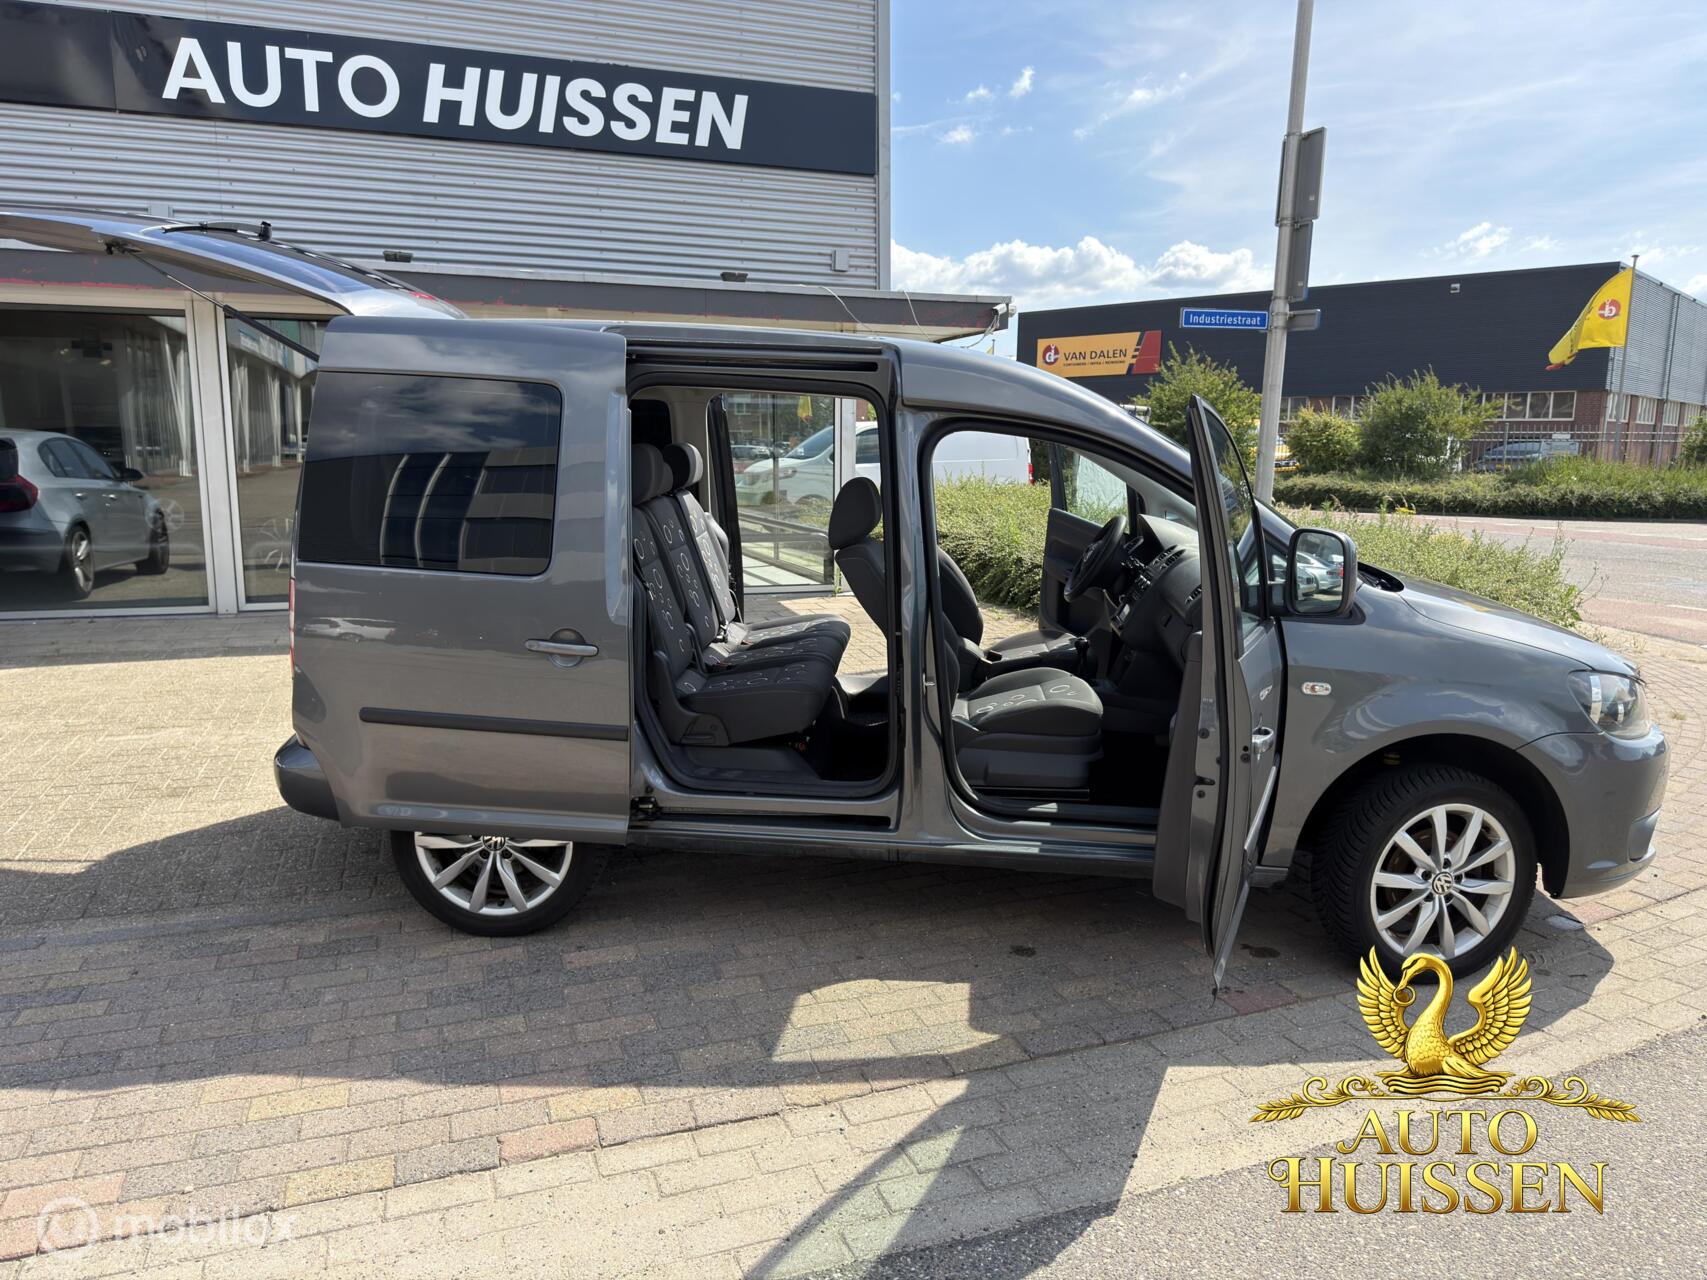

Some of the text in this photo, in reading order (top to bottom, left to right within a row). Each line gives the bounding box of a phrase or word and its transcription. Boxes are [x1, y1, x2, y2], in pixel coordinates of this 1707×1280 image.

[162, 38, 749, 151] AUTO HUISSEN
[1189, 313, 1261, 326] Industriestraat
[1063, 349, 1128, 361] VAN DALEN
